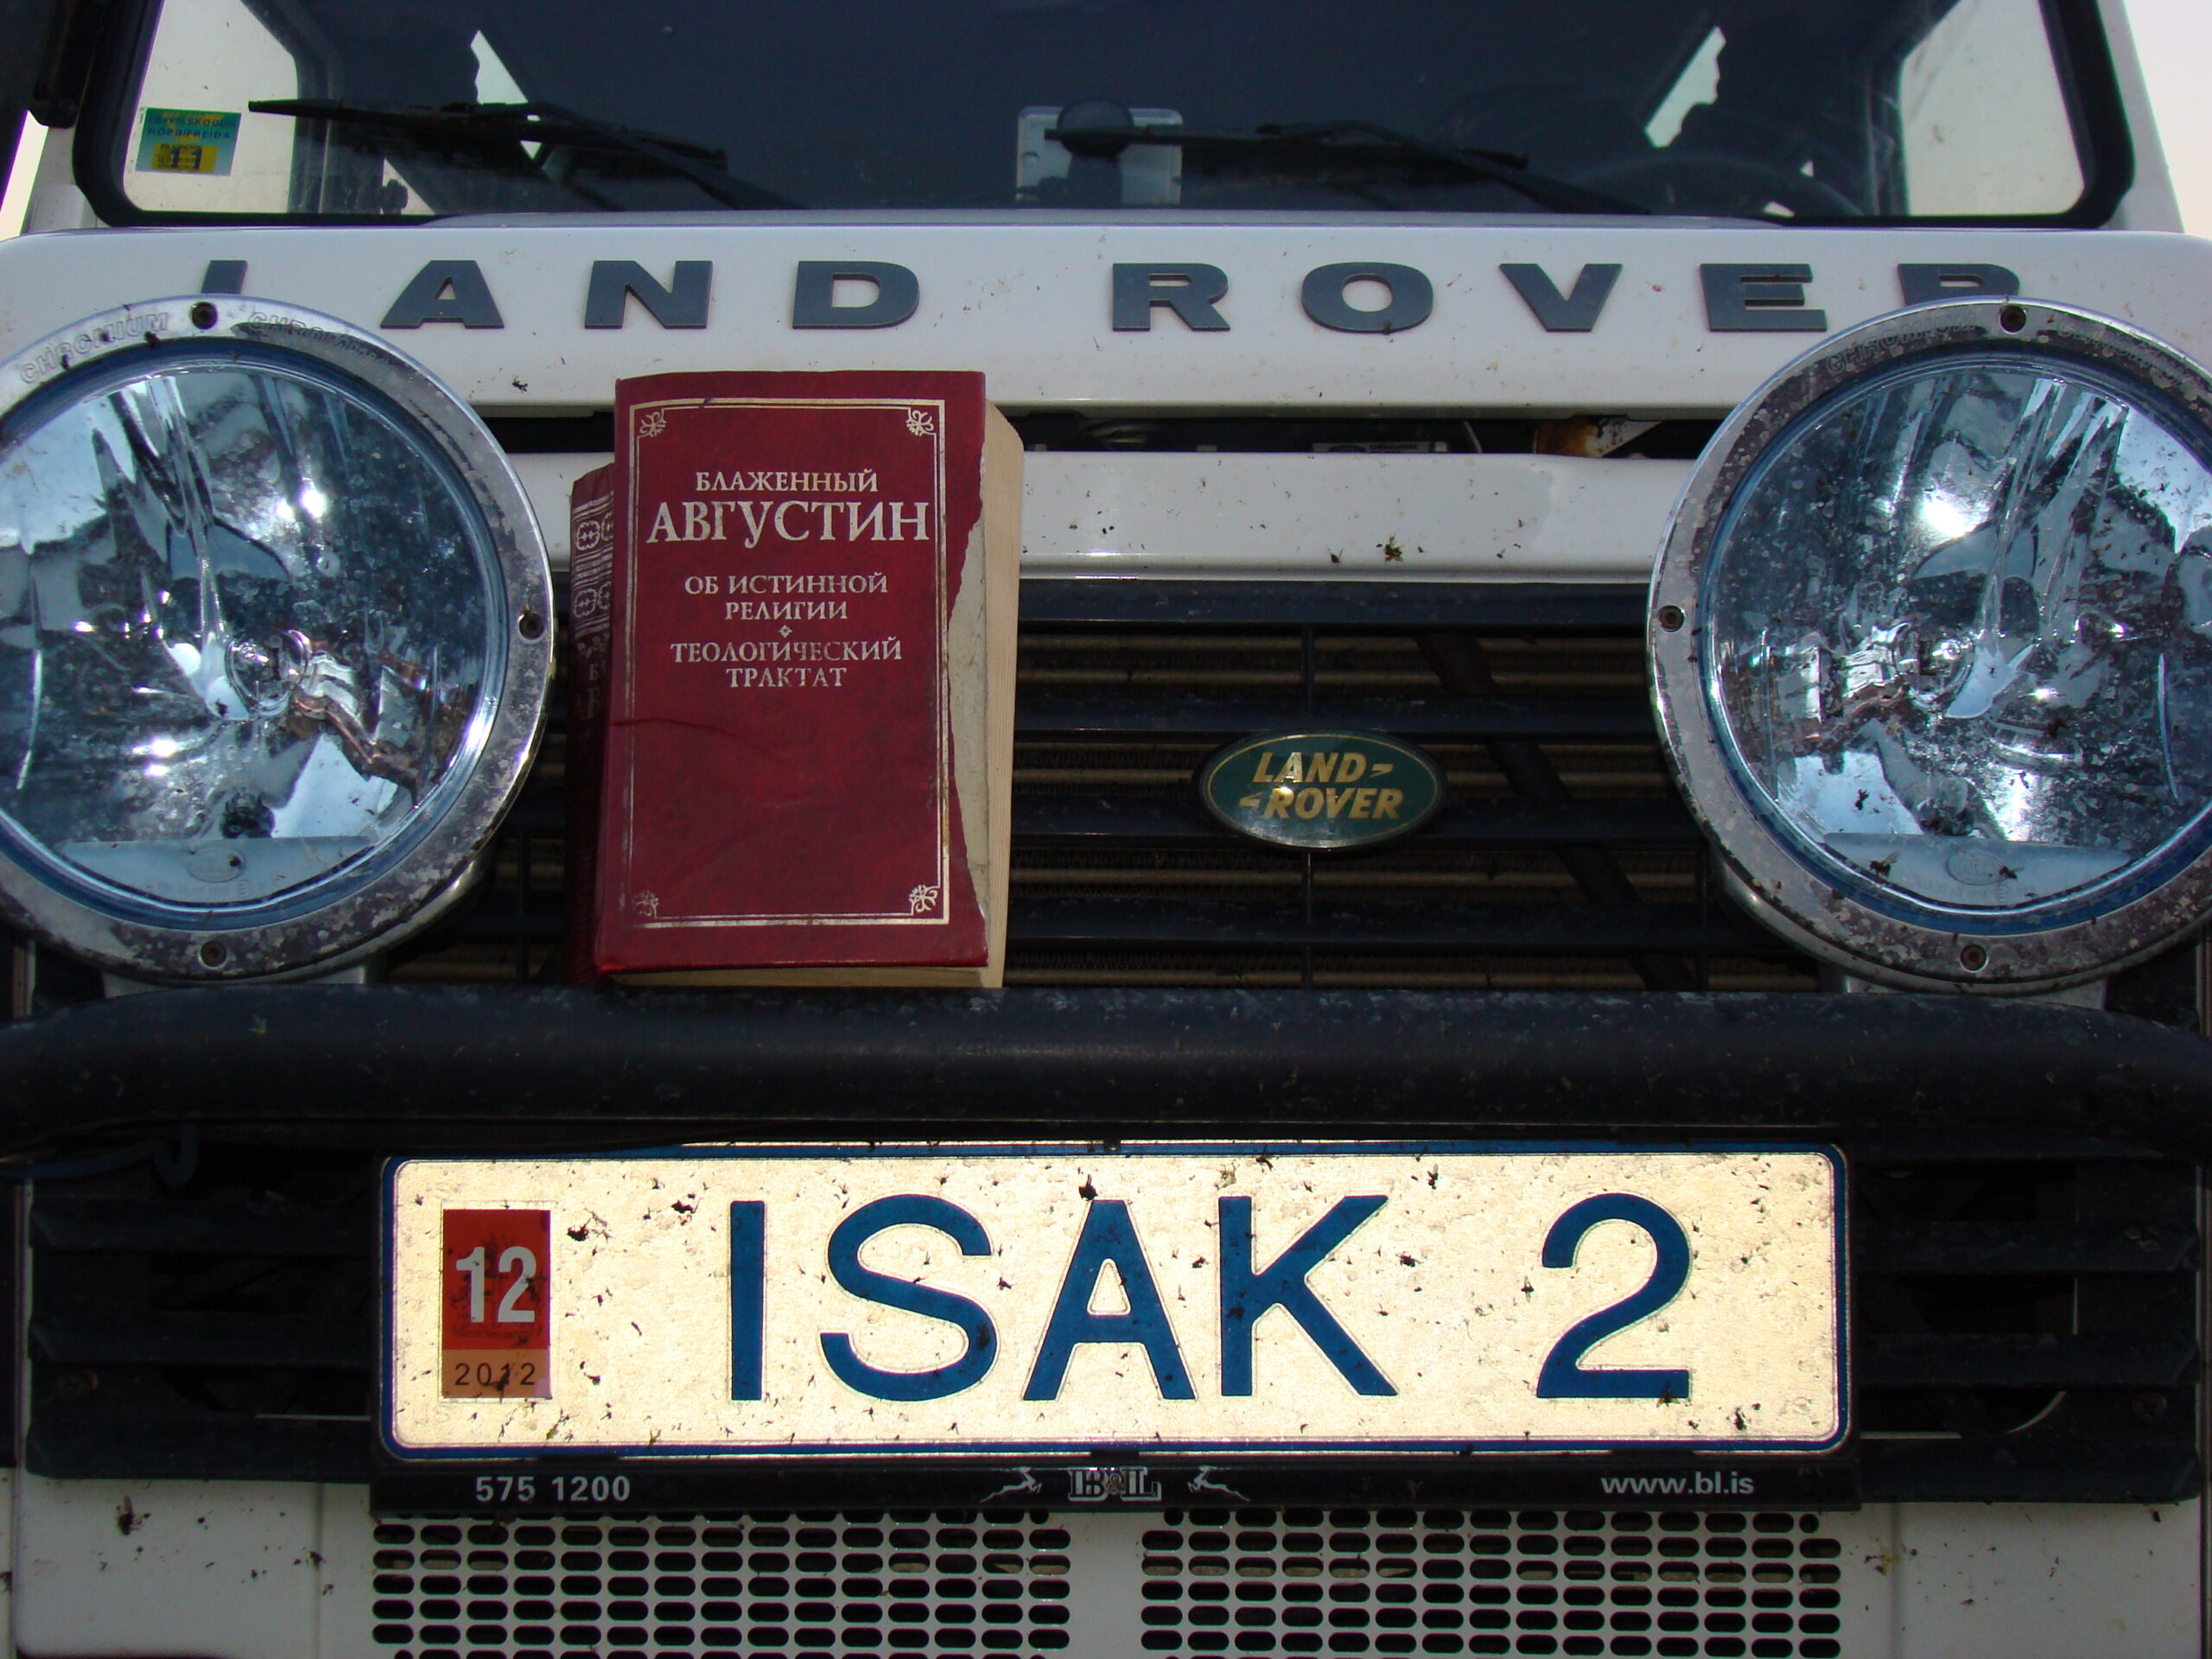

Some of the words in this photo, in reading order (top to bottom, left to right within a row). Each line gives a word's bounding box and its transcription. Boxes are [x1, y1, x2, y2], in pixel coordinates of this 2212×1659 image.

[696, 468, 878, 492] БЛАЖЕННЫЙ
[646, 500, 930, 549] АВГУСТИН
[684, 576, 719, 594] ОБ
[728, 572, 888, 594] ИСТИННОЙ
[725, 601, 848, 620] РЕЛИГИИ
[671, 636, 902, 663] ТЕОЛОГИЧЕСКИЙ
[726, 667, 847, 688] ТРАКТАТ
[455, 1246, 537, 1323] 12
[728, 1192, 1399, 1402] ISAK
[1535, 1192, 1692, 1400] 2
[454, 1363, 535, 1386] 2012
[476, 1476, 536, 1502] 575
[551, 1475, 631, 1502] 1200
[1600, 1471, 1755, 1494] www.bl.is
